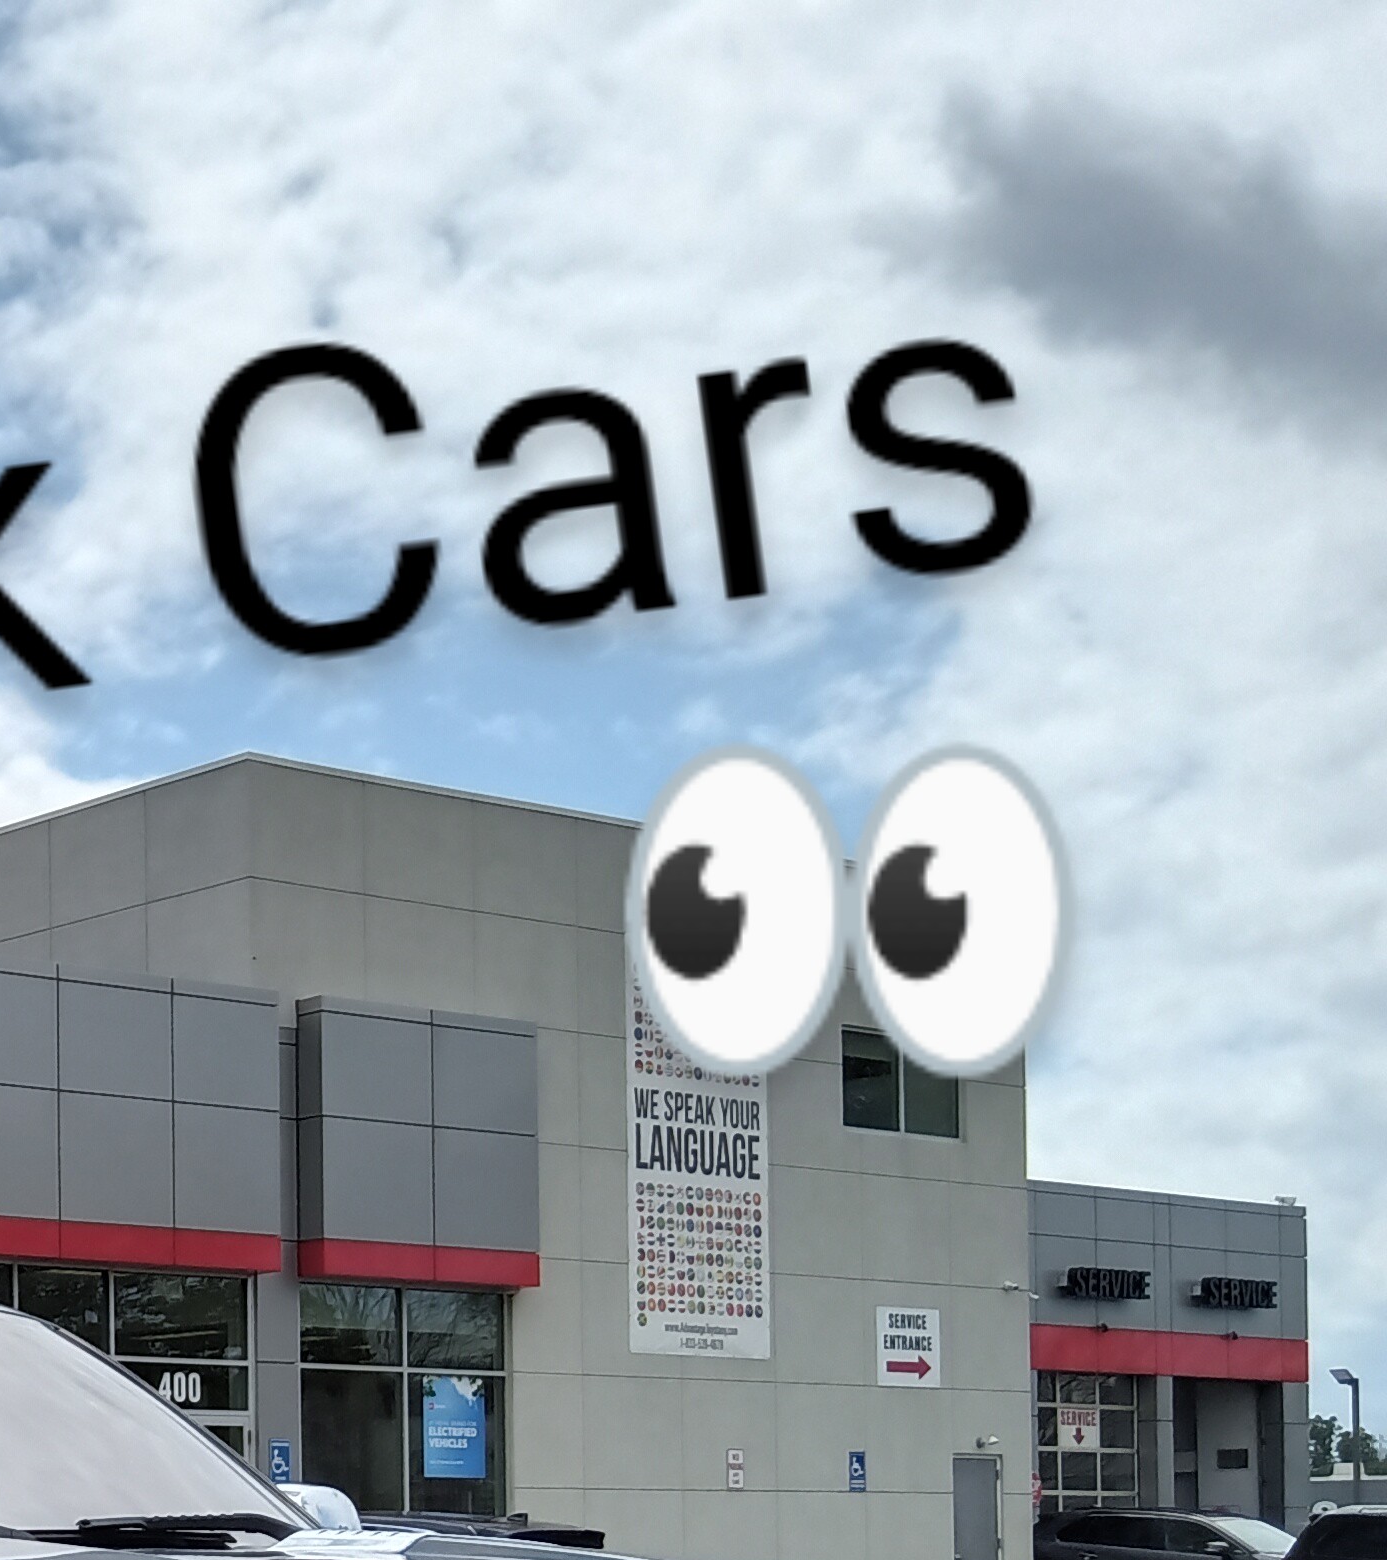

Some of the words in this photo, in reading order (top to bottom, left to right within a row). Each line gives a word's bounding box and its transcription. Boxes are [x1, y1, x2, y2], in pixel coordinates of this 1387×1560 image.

[633, 1086, 660, 1119] WE
[663, 1090, 716, 1126] SPEAK
[719, 1097, 761, 1131] YOUR
[635, 1122, 761, 1181] LANGUAGE
[1071, 1268, 1152, 1299] SERVICE
[1205, 1278, 1278, 1309] SERVICE
[888, 1313, 928, 1330] SERVICE
[883, 1333, 933, 1352] ENTRANCE
[158, 1371, 202, 1403] 400
[1060, 1410, 1097, 1427] SERVICE
